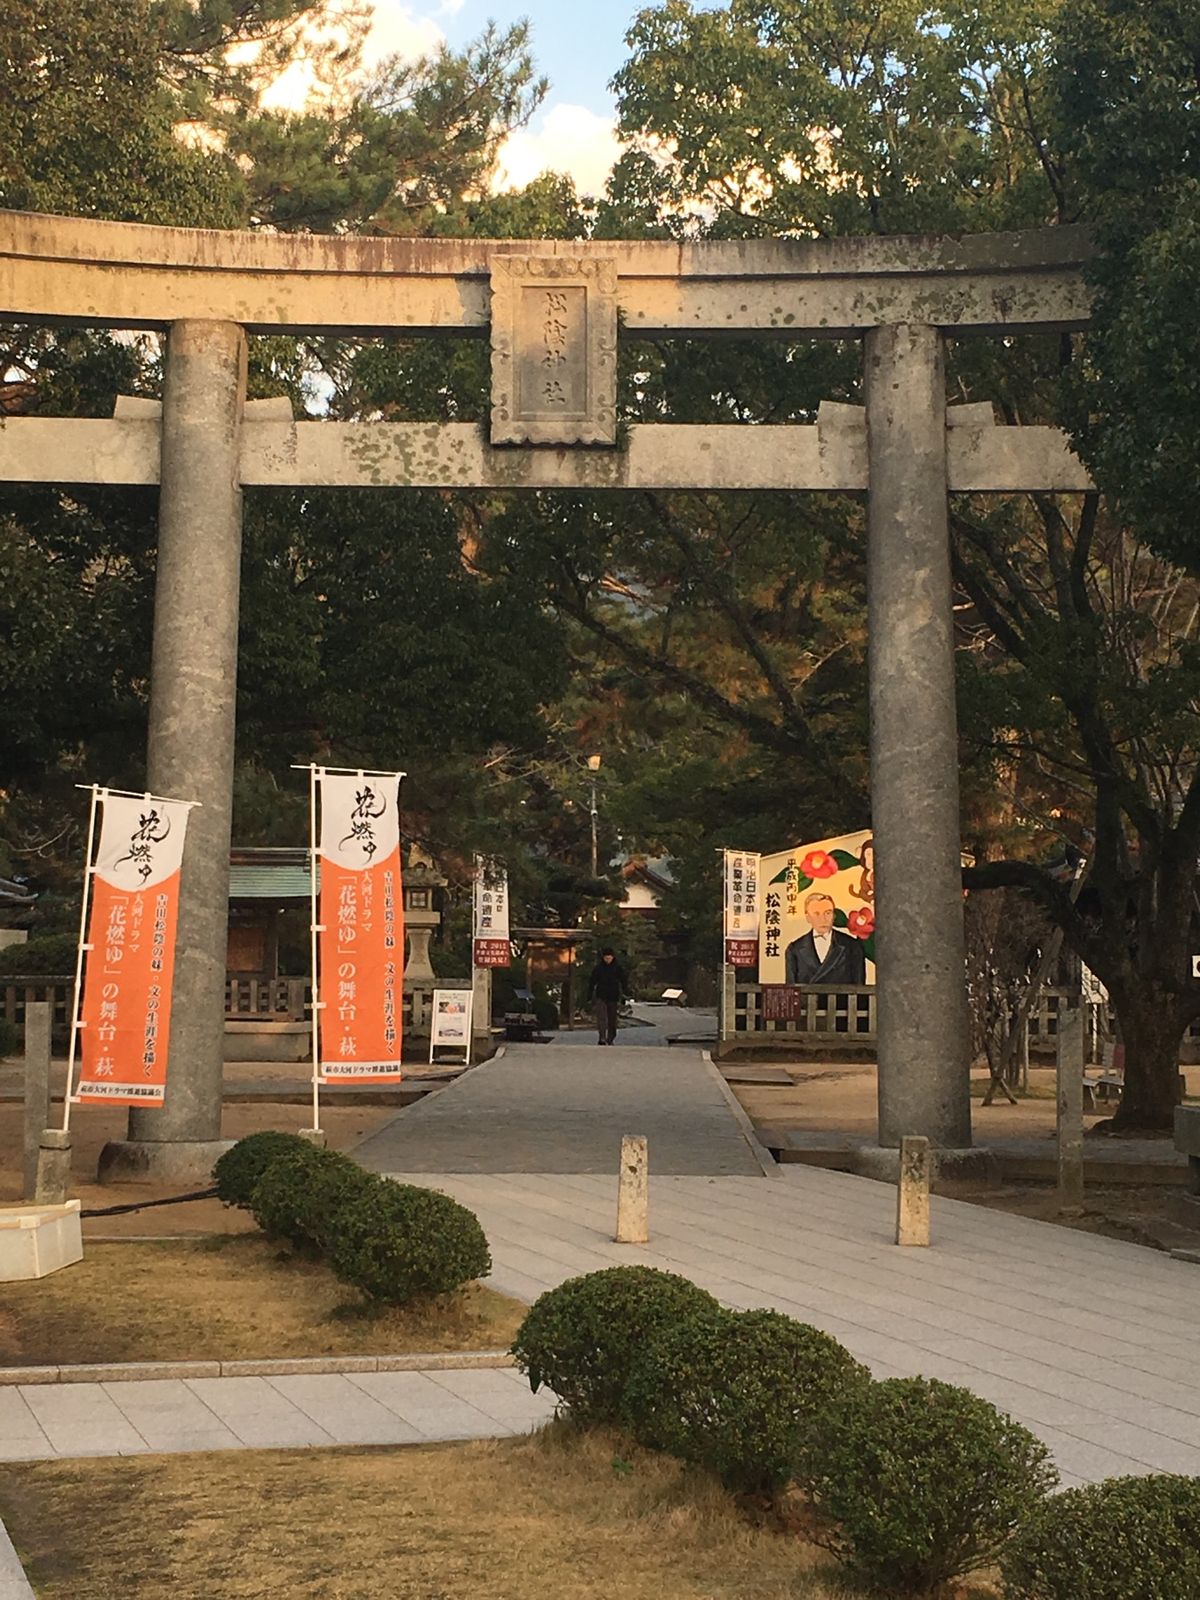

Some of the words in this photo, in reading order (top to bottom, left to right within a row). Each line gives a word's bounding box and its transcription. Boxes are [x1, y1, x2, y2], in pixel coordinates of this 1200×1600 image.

[112, 804, 172, 887] 花燃ゆ
[338, 781, 388, 864] 花燃ゆ
[360, 869, 374, 933] 大河ドラマ
[744, 856, 758, 914] 明治日本の
[784, 858, 800, 918] 平成丙申年
[128, 893, 145, 955] 大河ドラマ
[764, 891, 782, 959] 松陰神社
[95, 893, 130, 1077] 「花燃ゆ」の舞台・萩
[337, 874, 358, 1057] 「花燃ゆ」の舞台・萩
